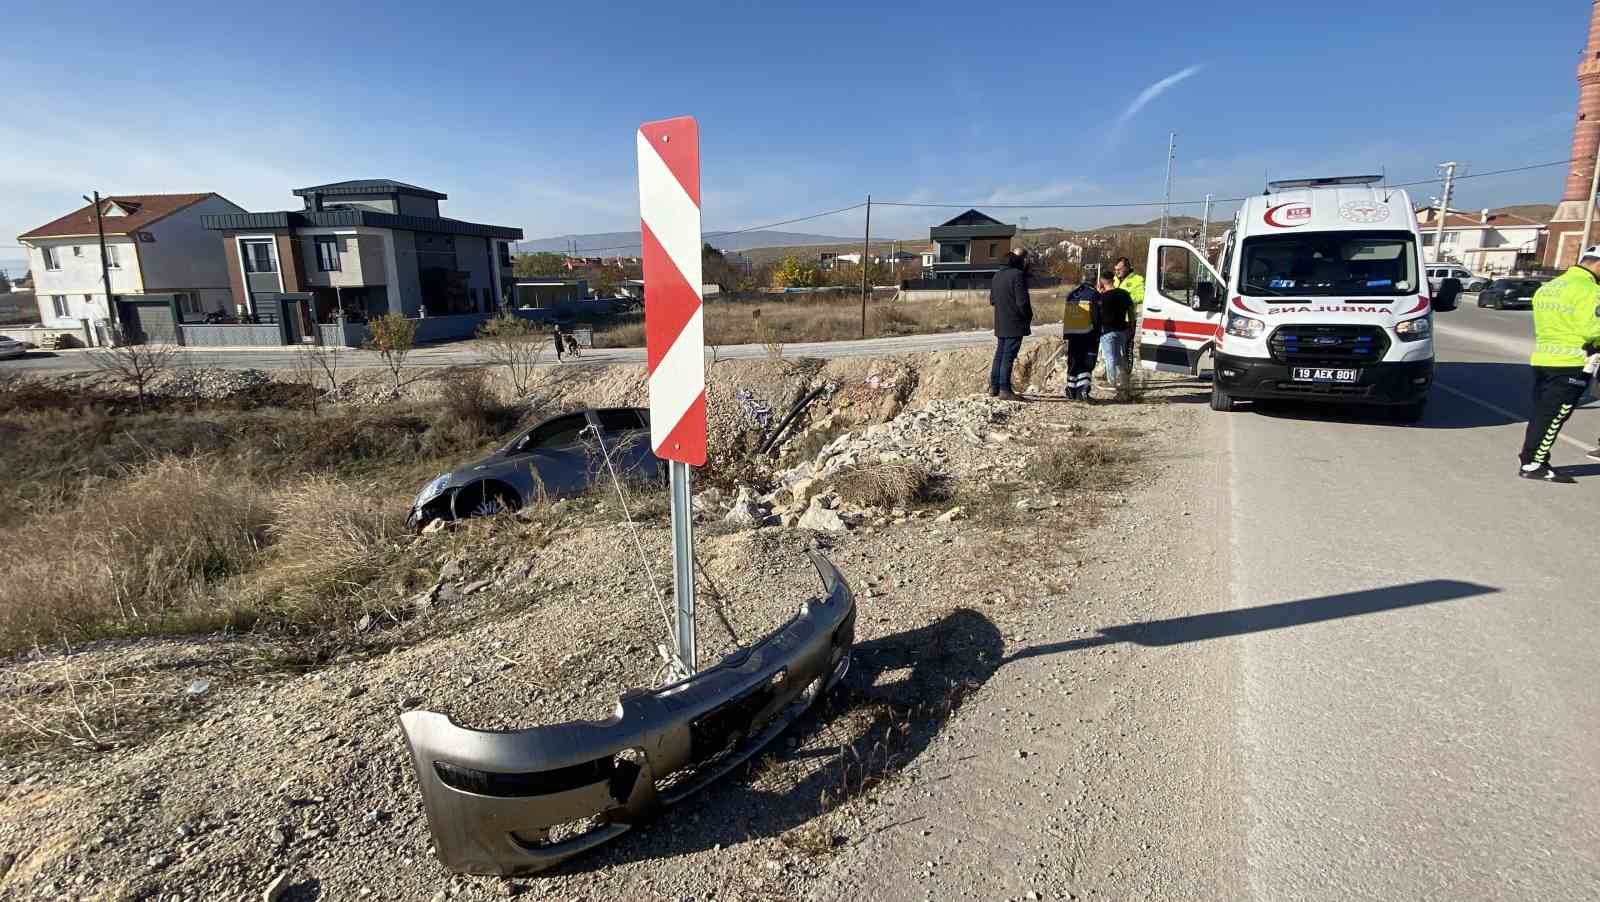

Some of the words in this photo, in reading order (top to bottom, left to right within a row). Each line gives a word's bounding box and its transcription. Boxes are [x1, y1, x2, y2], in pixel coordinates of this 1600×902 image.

[1299, 369, 1310, 378] 19
[1314, 370, 1334, 379] AEK
[1336, 370, 1354, 380] 801
